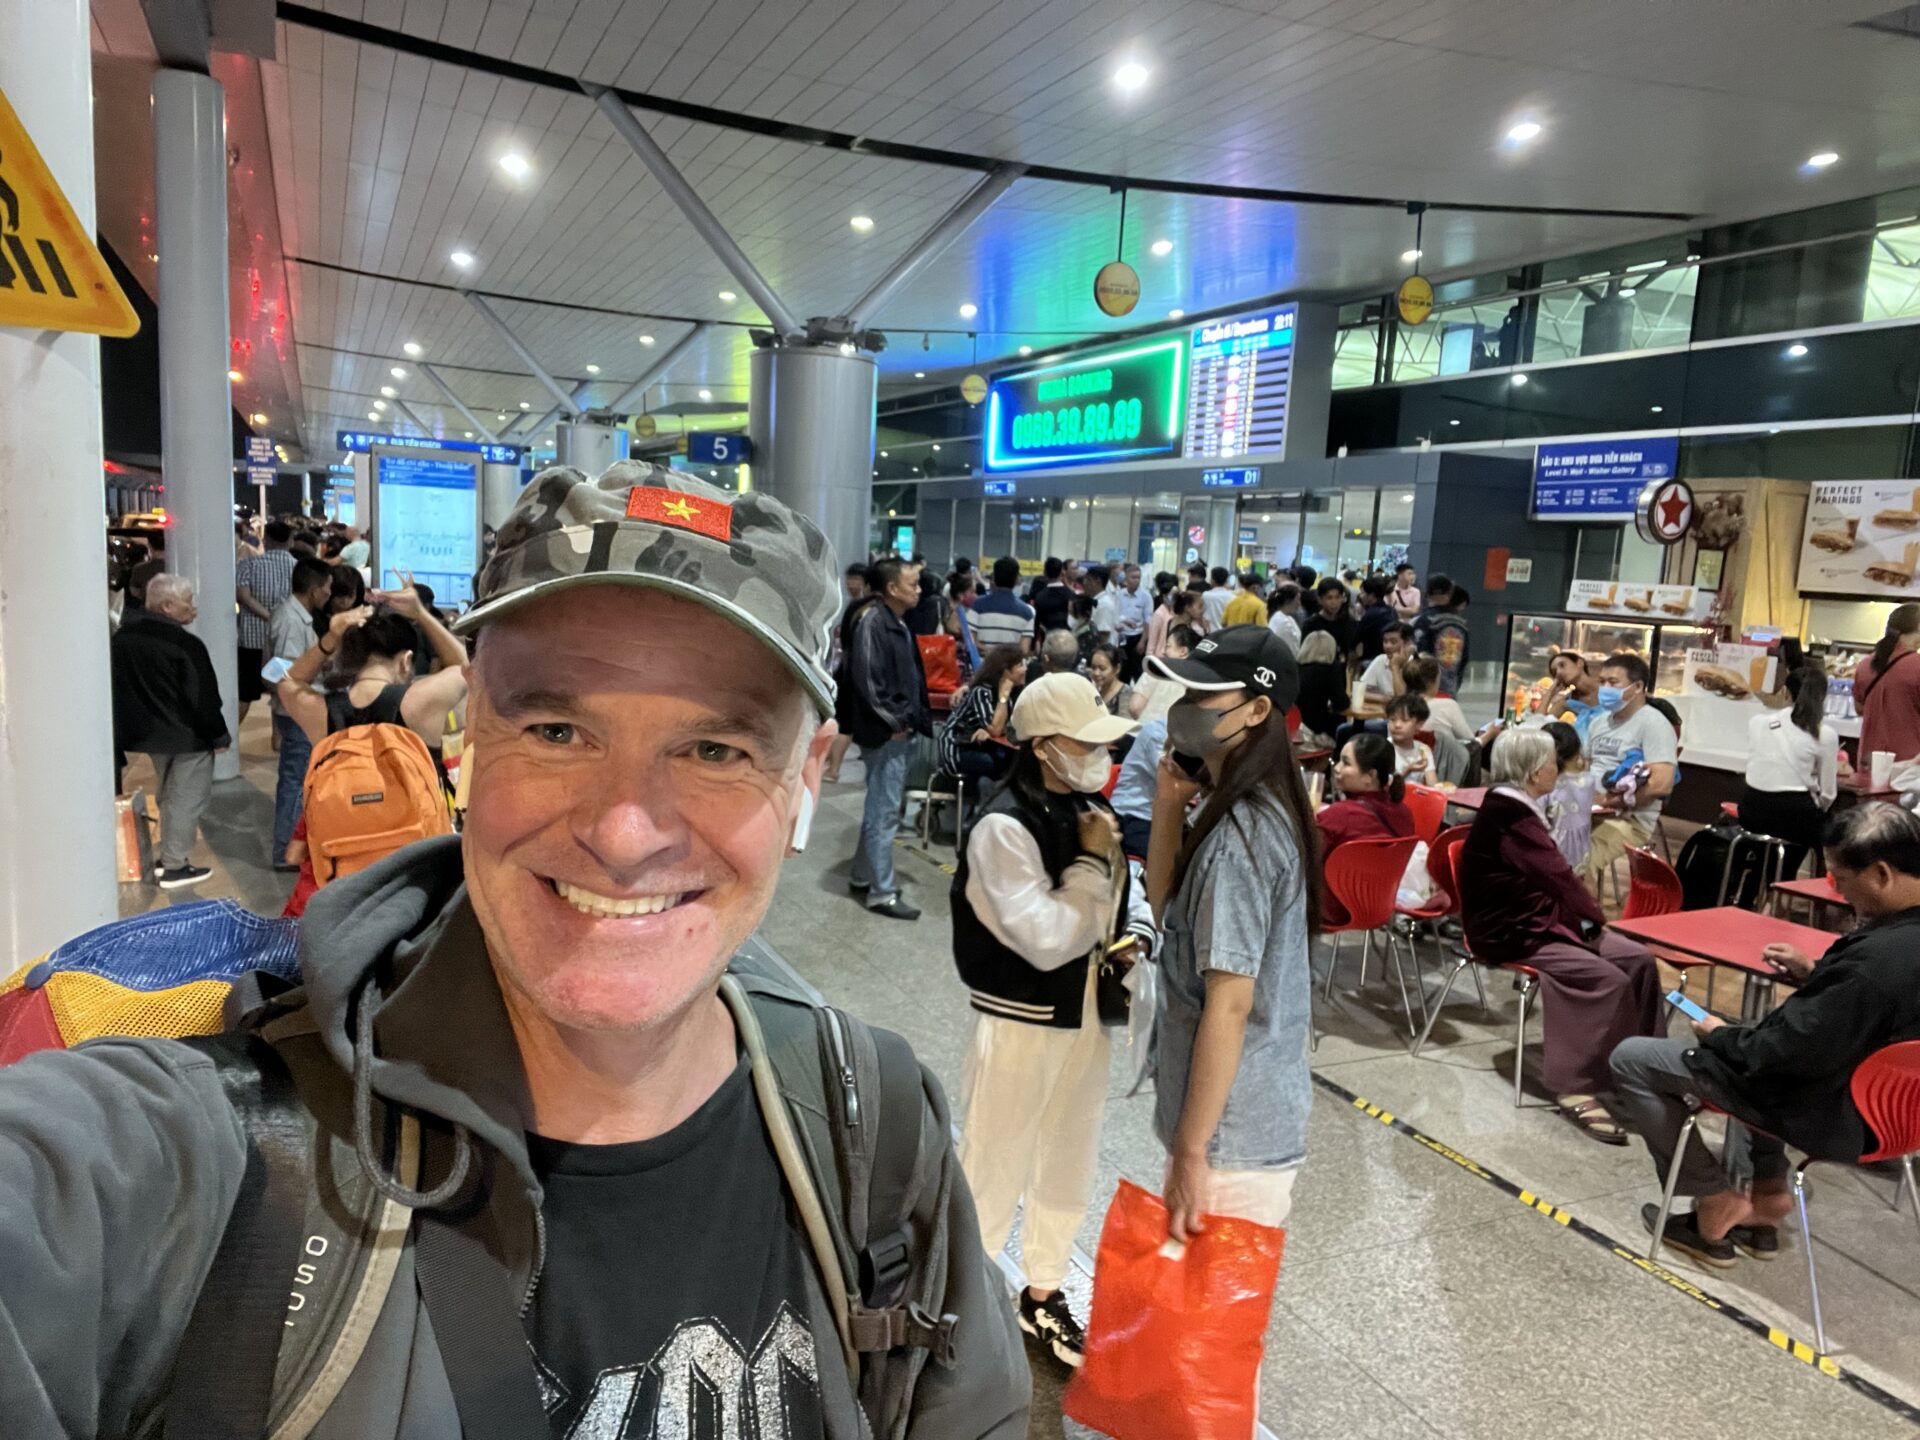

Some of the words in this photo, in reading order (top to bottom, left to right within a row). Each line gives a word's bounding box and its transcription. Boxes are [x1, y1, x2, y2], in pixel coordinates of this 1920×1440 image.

[713, 437, 728, 460] 5
[1816, 486, 1863, 495] PERFECT
[1815, 495, 1862, 504] PAIRINGS
